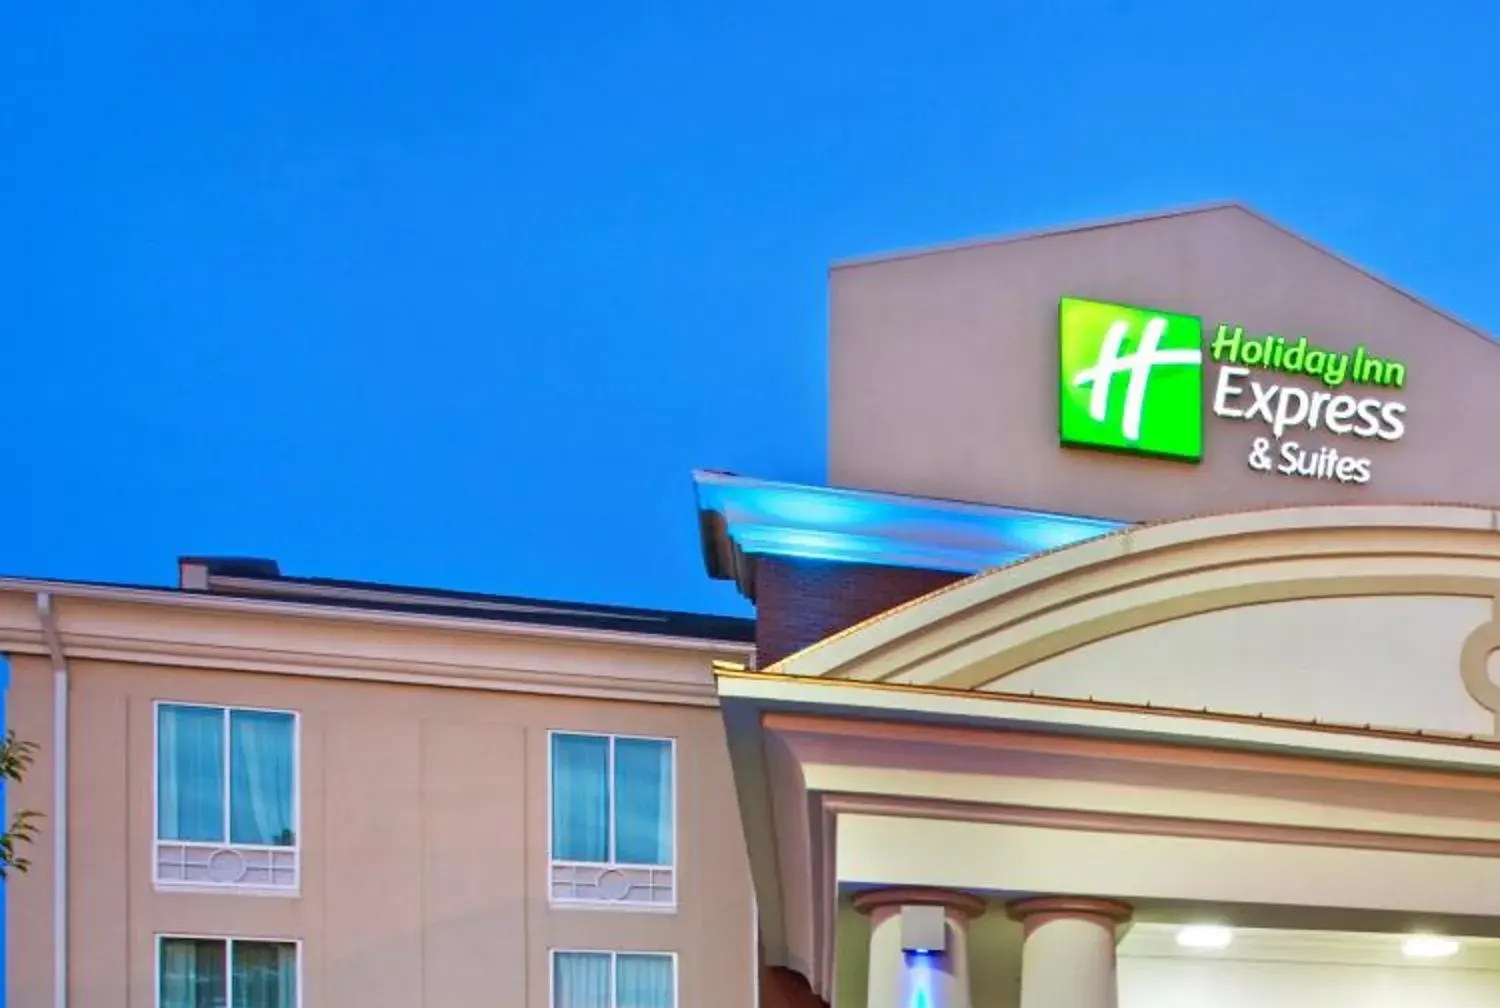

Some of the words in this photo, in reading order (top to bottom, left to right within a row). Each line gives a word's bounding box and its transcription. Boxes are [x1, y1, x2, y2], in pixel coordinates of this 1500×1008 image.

[1211, 325, 1349, 386] Holiday
[1353, 346, 1405, 387] Inn
[1213, 365, 1407, 441] Express
[1249, 437, 1273, 471] &
[1278, 441, 1372, 484] Suites
